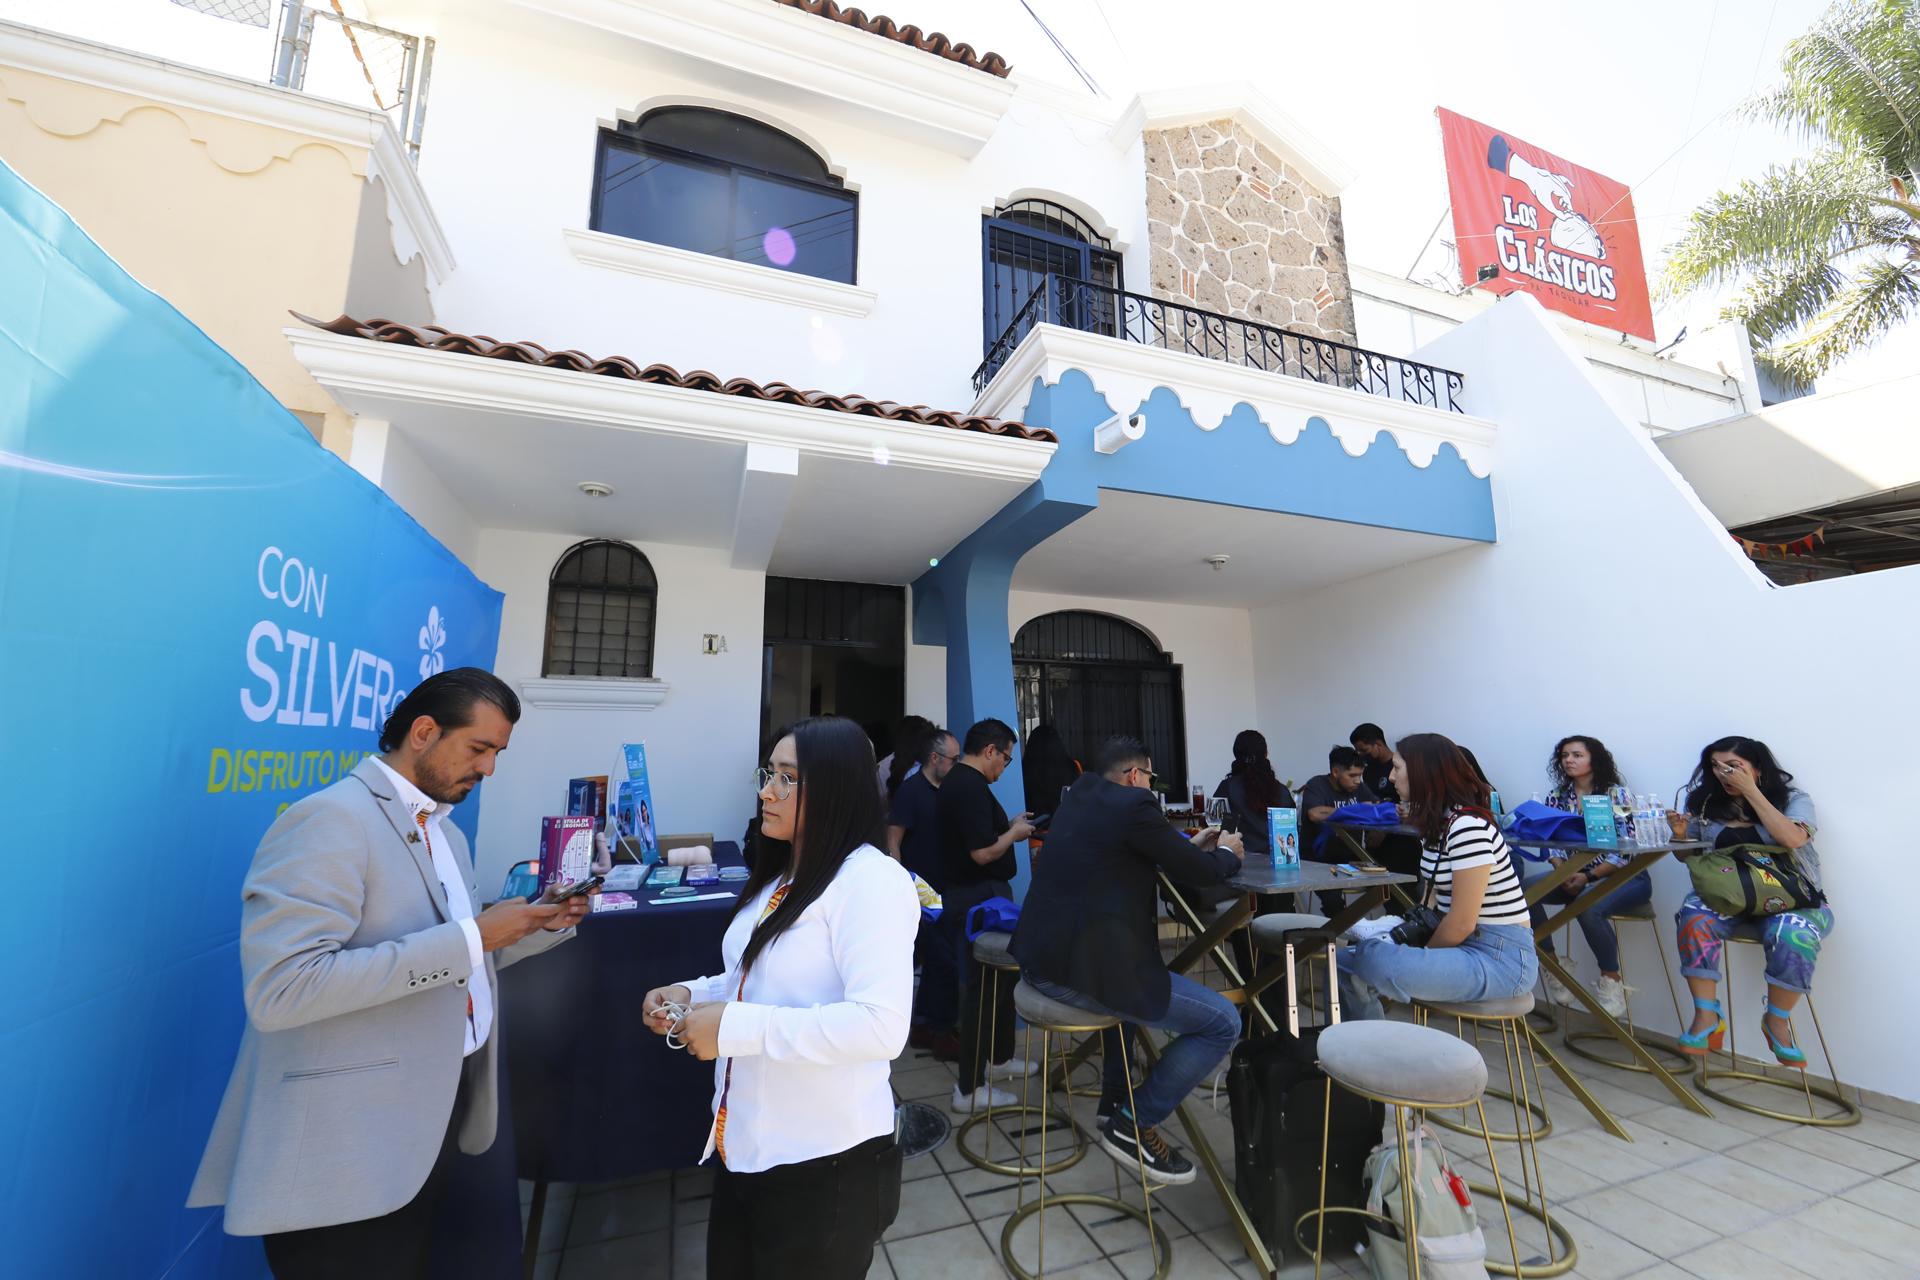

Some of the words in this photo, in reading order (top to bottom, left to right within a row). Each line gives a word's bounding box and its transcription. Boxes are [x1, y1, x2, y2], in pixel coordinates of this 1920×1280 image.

[1502, 194, 1538, 231] LOS
[1495, 224, 1617, 301] CLÁSICOS
[258, 546, 328, 619] CON
[207, 748, 335, 794] DISFRUTO
